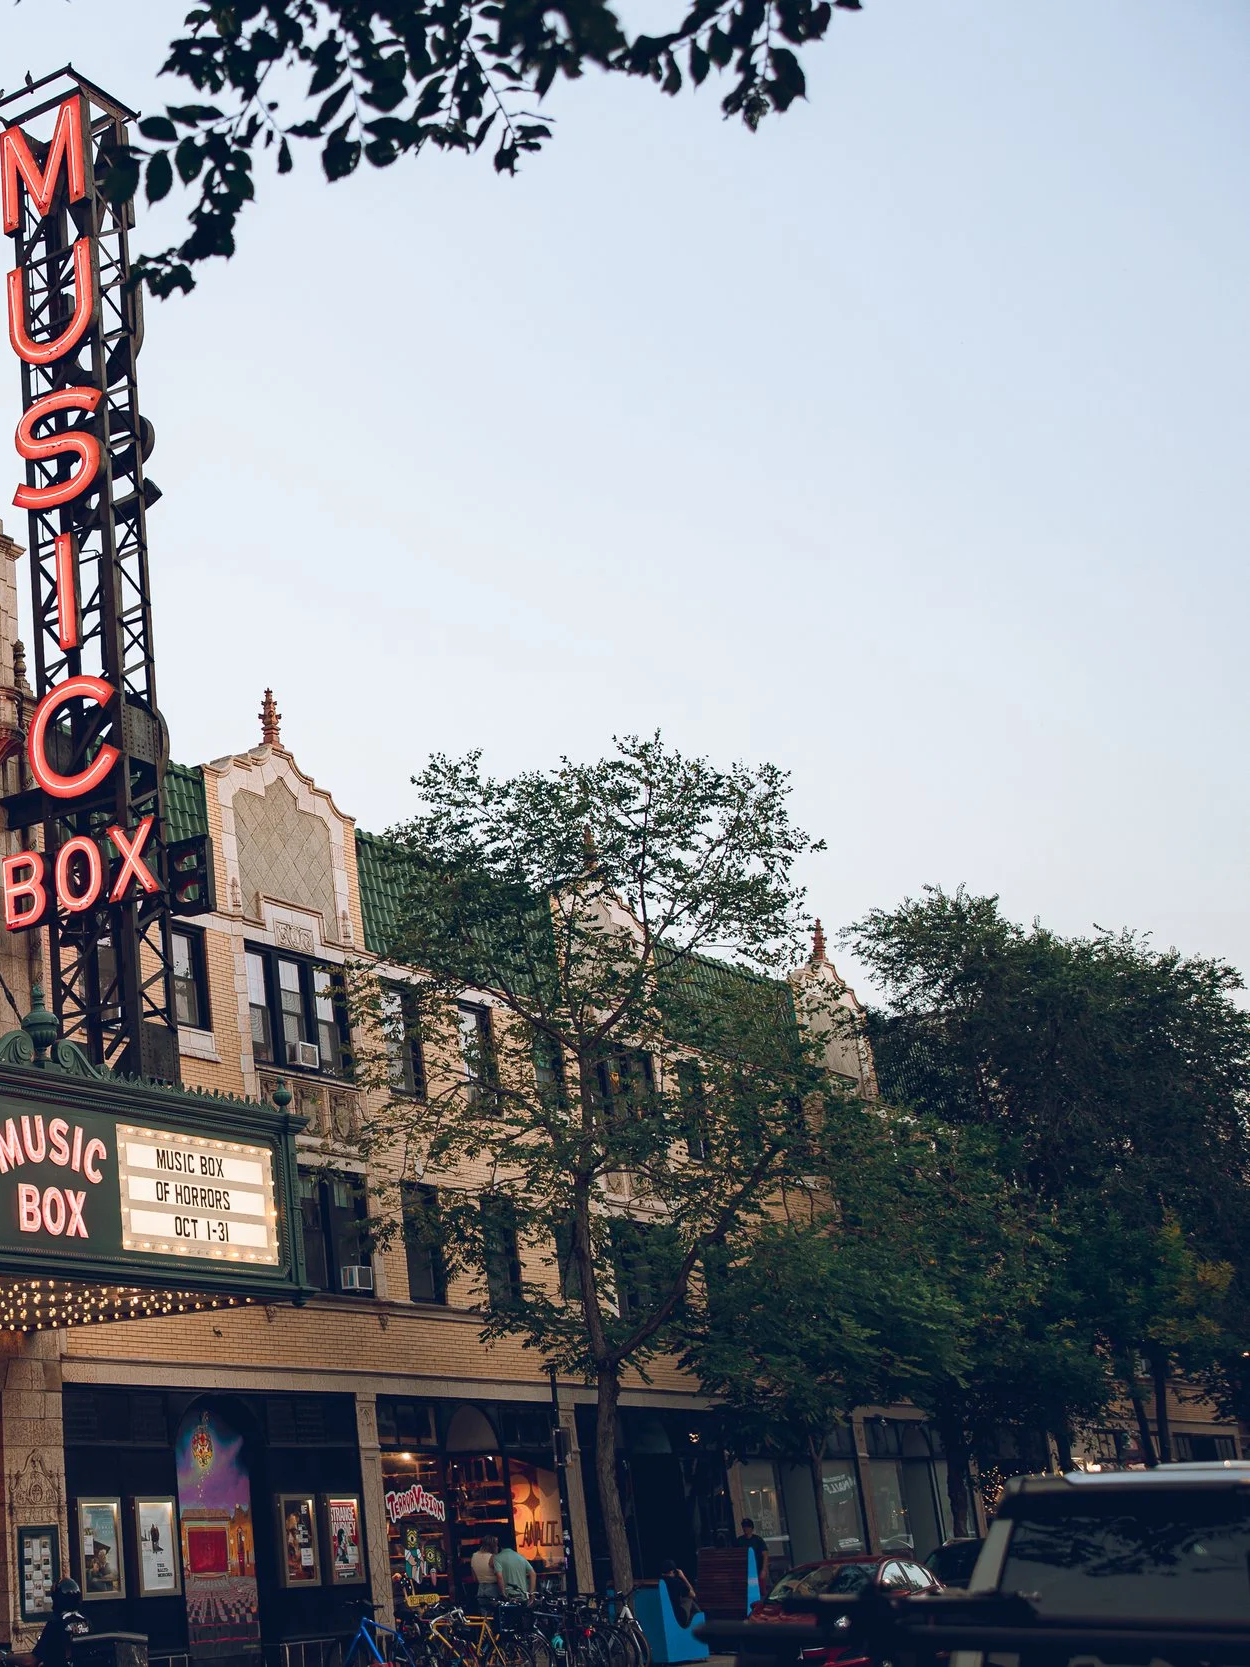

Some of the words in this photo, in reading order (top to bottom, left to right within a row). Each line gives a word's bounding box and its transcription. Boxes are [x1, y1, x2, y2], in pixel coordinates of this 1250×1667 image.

[0, 94, 121, 798] MUSIC
[2, 816, 160, 932] BOX
[156, 1148, 195, 1175] MUSIC
[200, 1155, 224, 1178] BOX
[17, 1182, 90, 1239] BOX
[155, 1181, 169, 1203] OF
[175, 1184, 231, 1211] HORRORS
[174, 1216, 198, 1240] OCT
[207, 1219, 229, 1243] 1-31
[330, 1506, 355, 1521] STRANGE
